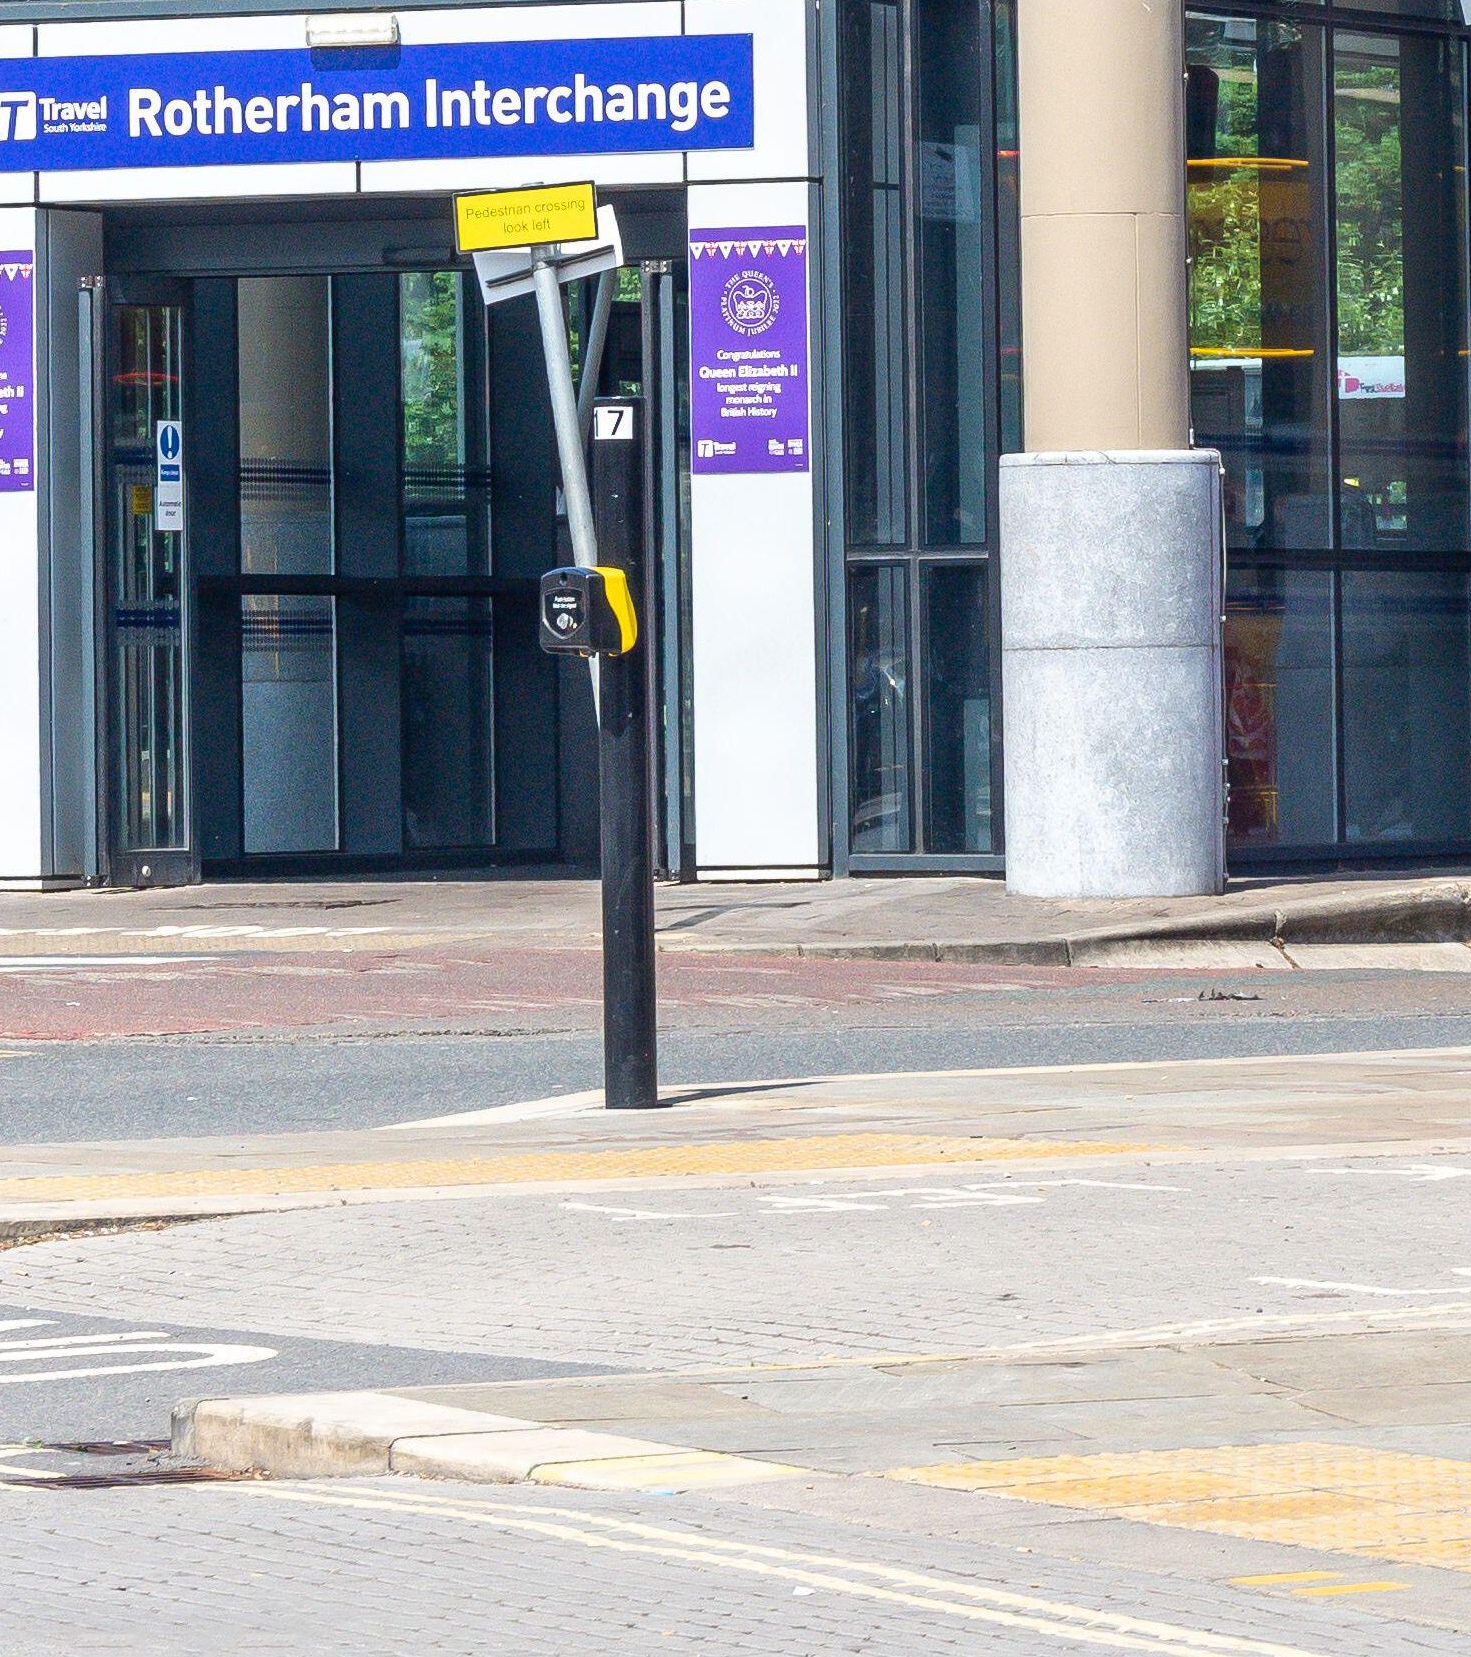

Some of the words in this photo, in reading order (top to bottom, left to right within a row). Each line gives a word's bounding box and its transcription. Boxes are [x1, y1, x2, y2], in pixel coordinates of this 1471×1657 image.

[39, 96, 107, 120] Travel
[129, 81, 411, 139] Rotherham
[425, 73, 731, 133] Interchange
[43, 123, 68, 133] South
[69, 122, 107, 132] Yorkshire
[466, 203, 531, 220] Pedestrian
[534, 198, 586, 213] crossing
[503, 219, 529, 233] look
[533, 217, 551, 231] left
[716, 349, 781, 362] Congratulations
[699, 366, 736, 379] Queen
[738, 364, 789, 378] Elizabeth
[716, 382, 747, 394] longest
[748, 381, 781, 394] reigning
[725, 394, 762, 405] monarch
[763, 394, 773, 404] in
[720, 407, 747, 417] British
[748, 406, 778, 418] History
